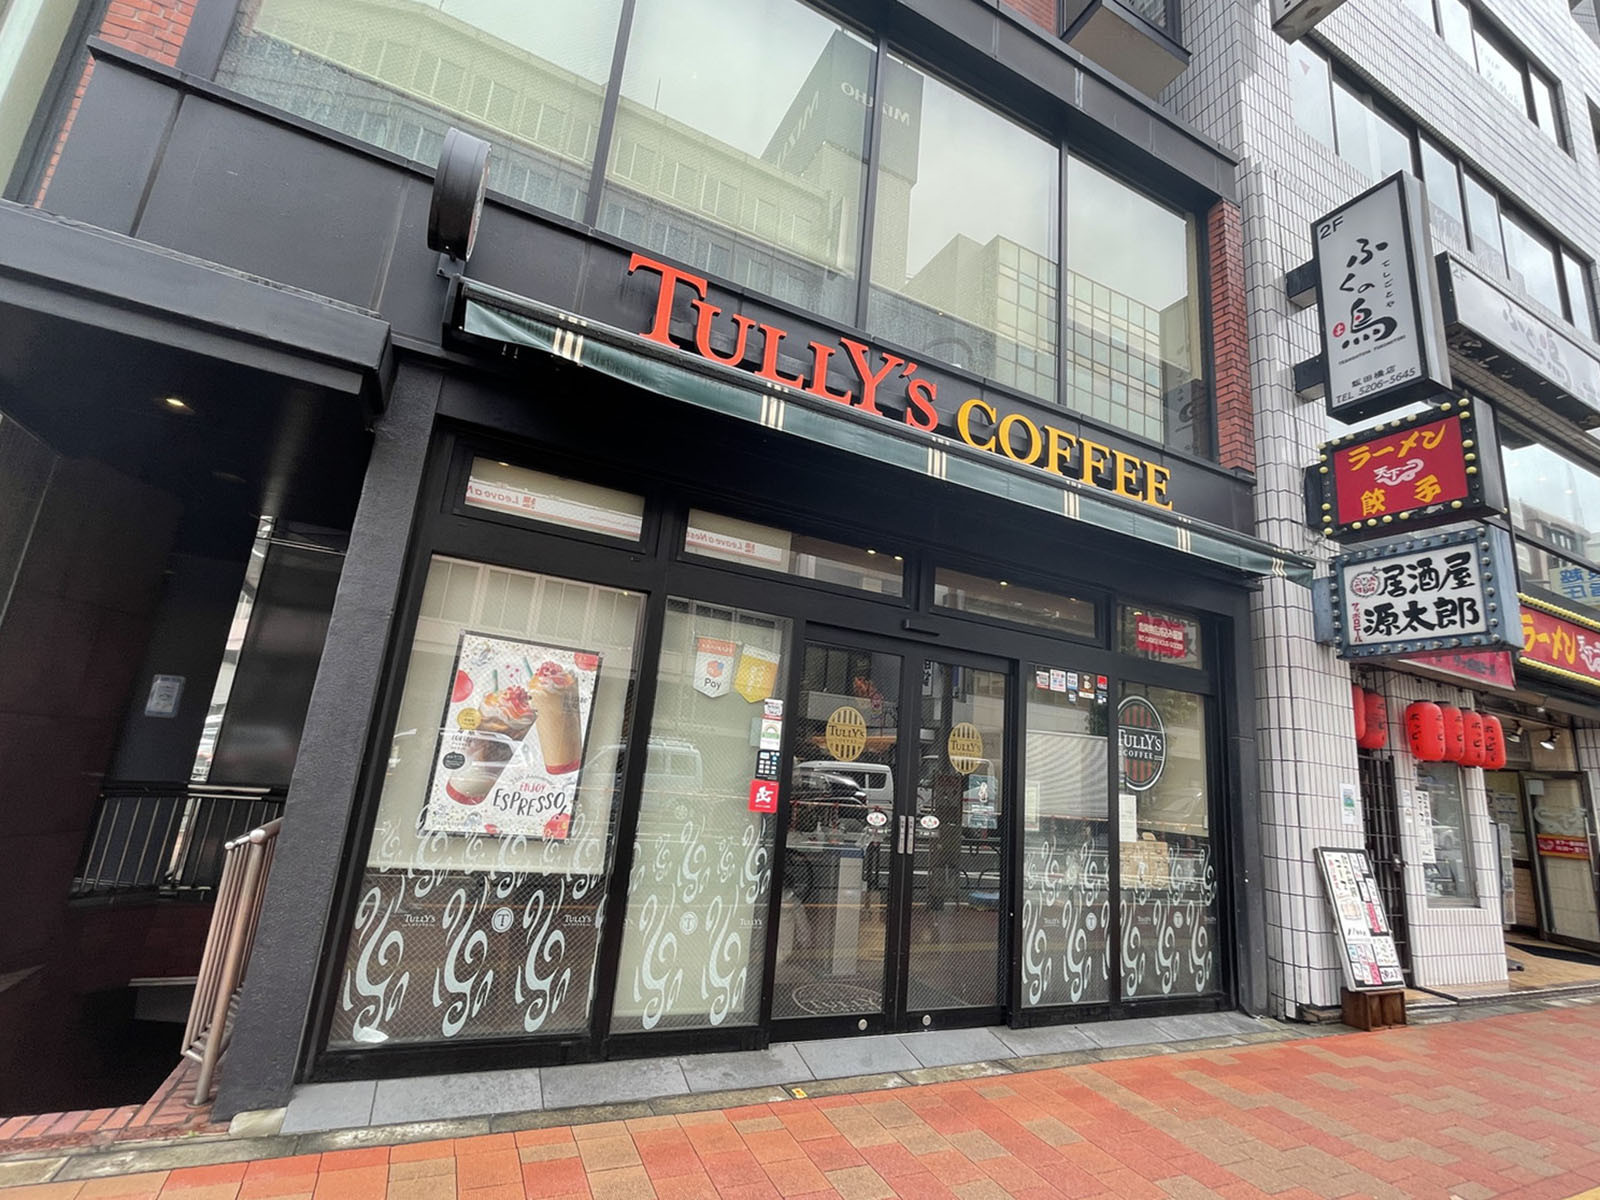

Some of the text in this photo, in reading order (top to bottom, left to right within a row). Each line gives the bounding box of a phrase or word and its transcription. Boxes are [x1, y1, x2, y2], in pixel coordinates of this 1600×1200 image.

[1319, 215, 1344, 241] 2F
[628, 252, 1173, 511] TULLY'S COFFEE
[1336, 367, 1416, 404] TEL 5206-5645
[1348, 423, 1447, 472] ラーメン
[1377, 551, 1476, 597] 居酒屋
[1363, 596, 1480, 637] 源太郎
[704, 677, 721, 691] Pay
[519, 783, 547, 793] ENJOY
